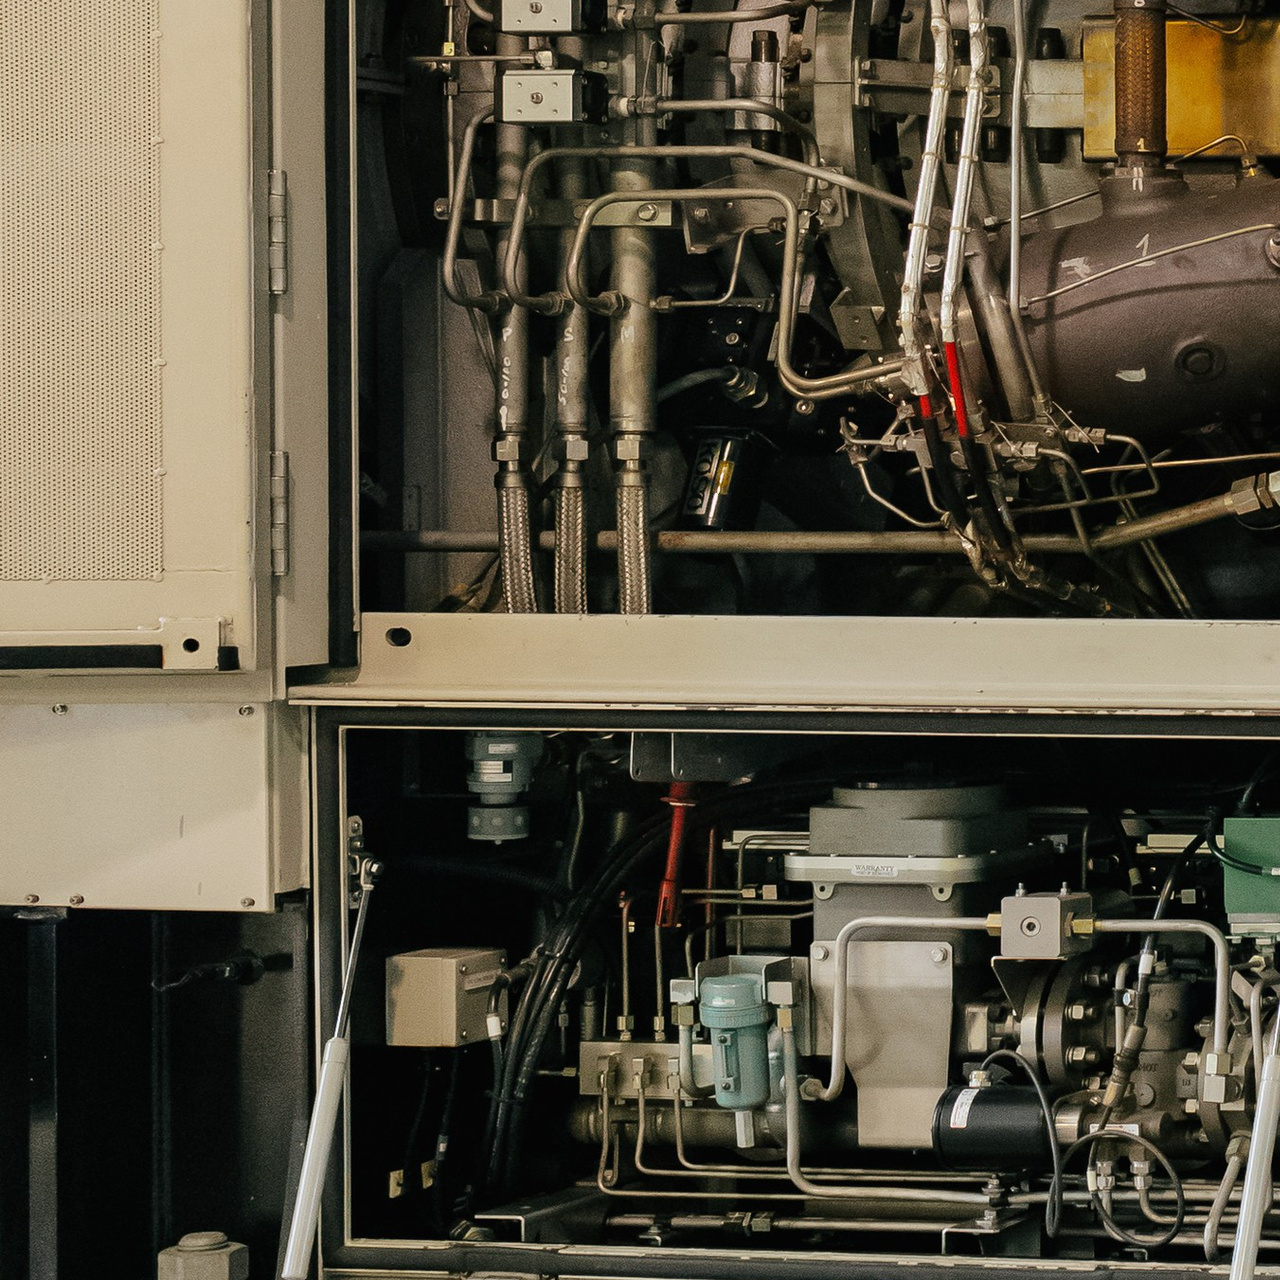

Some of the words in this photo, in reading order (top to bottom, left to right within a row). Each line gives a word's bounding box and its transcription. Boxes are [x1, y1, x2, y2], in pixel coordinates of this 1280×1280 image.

[1136, 137, 1151, 152] 1
[1135, 233, 1156, 267] 1
[502, 327, 513, 342] P
[564, 327, 574, 342] S
[621, 325, 635, 344] M
